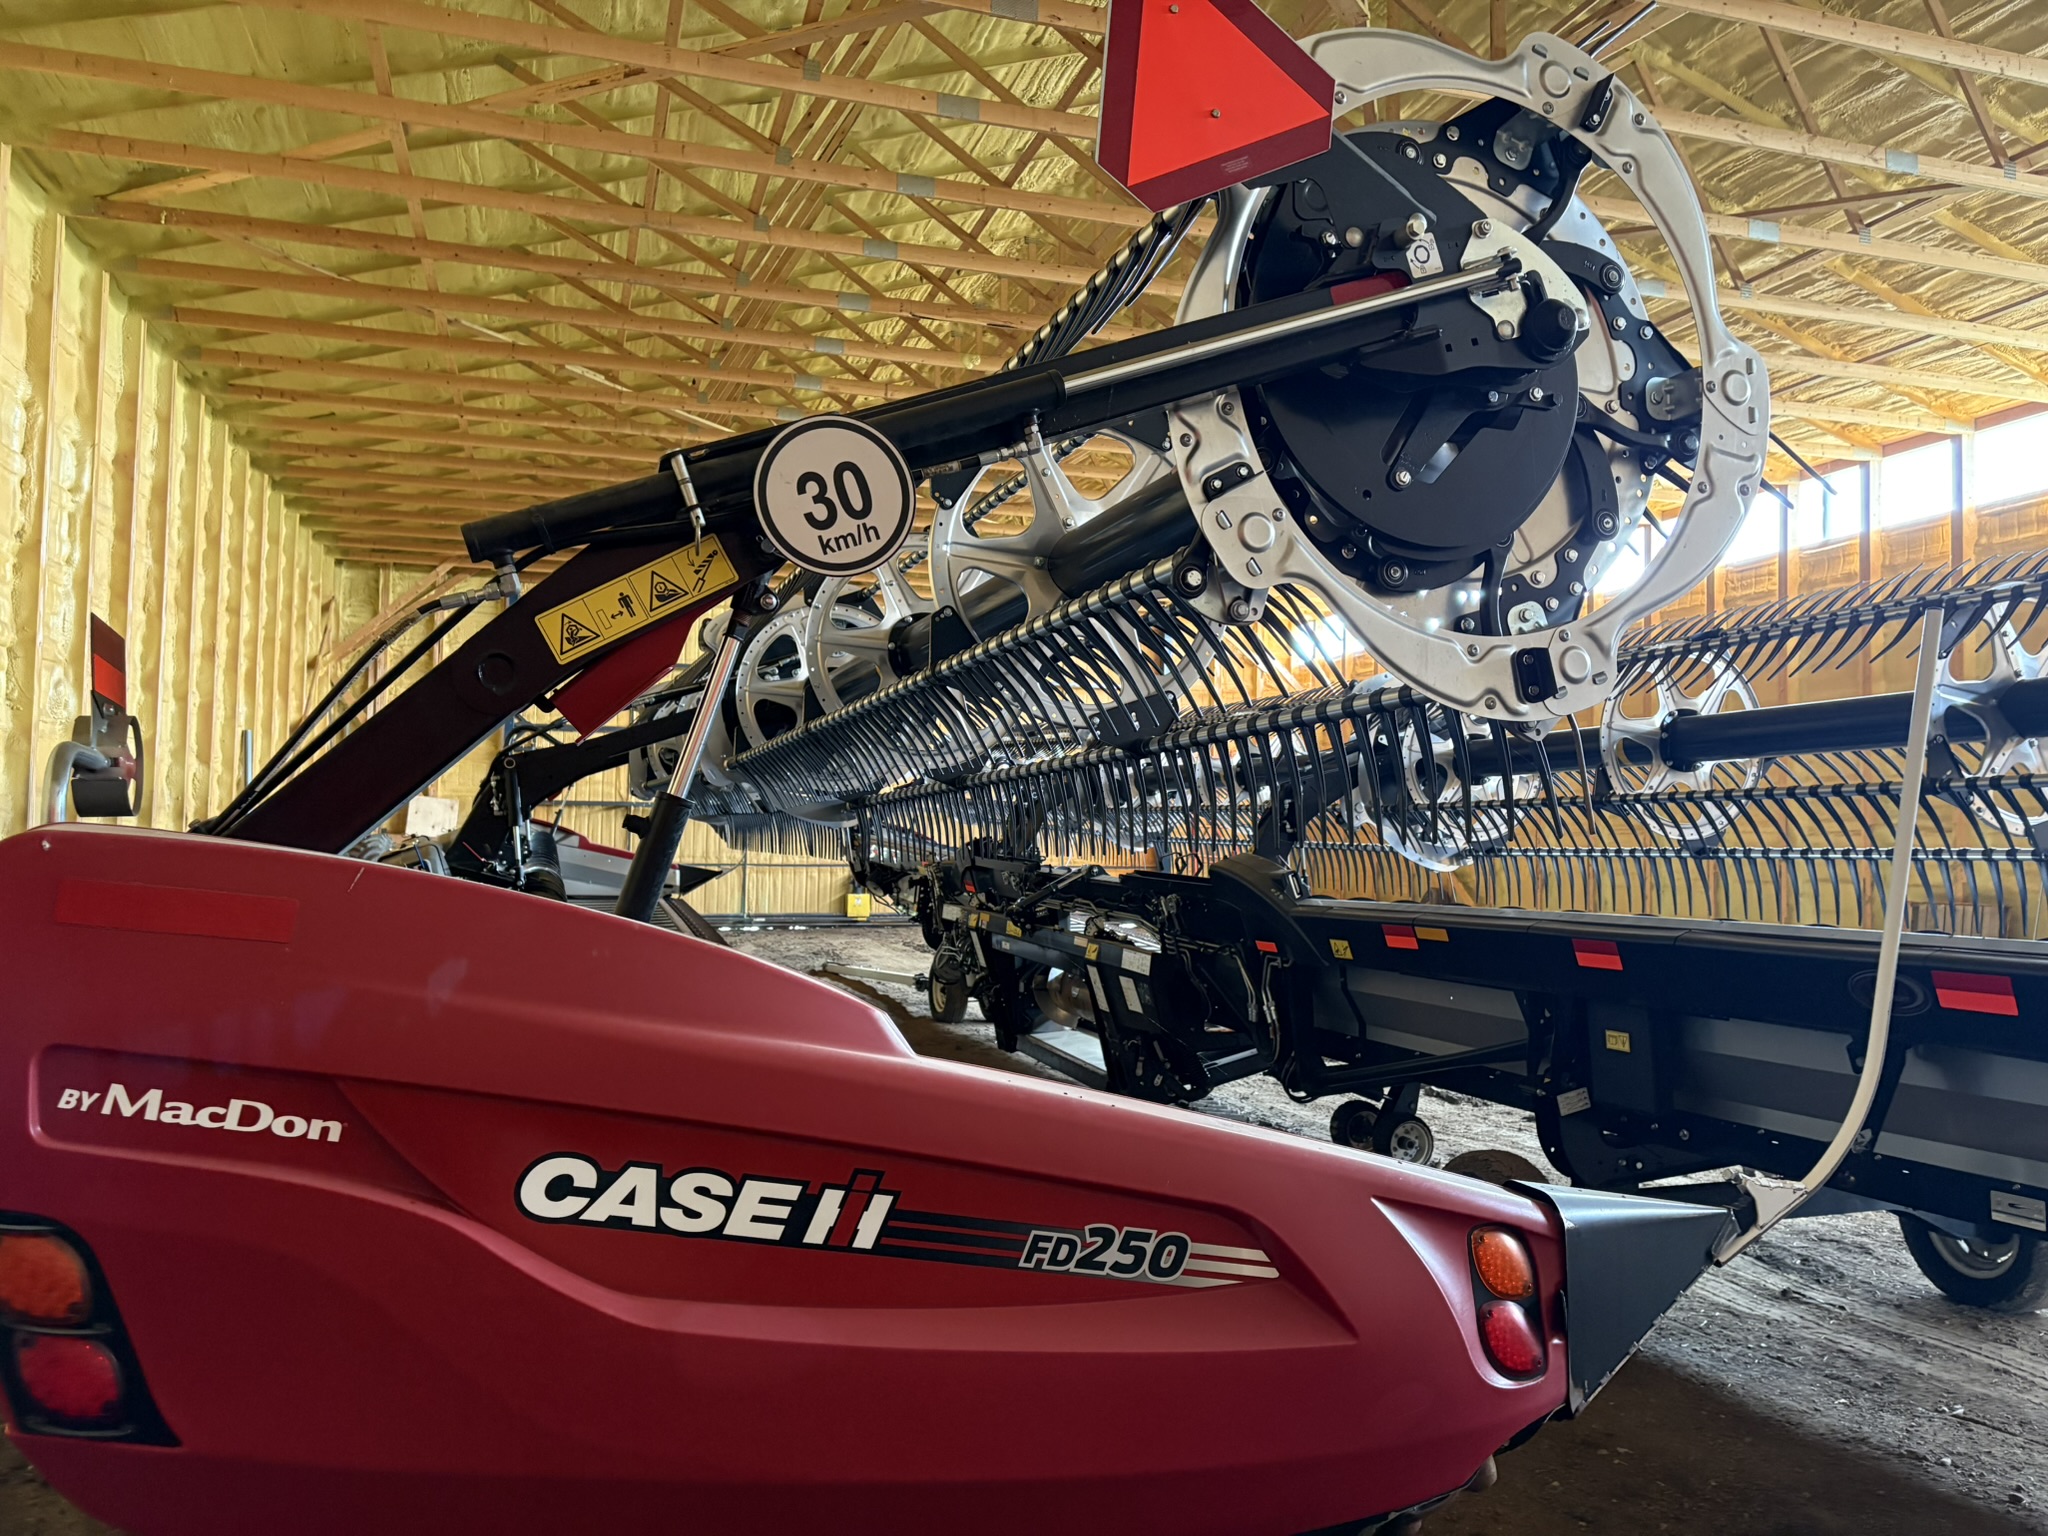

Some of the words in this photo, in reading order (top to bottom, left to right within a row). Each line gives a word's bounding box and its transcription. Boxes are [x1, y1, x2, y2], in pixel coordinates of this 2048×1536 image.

[796, 460, 873, 531] 30
[817, 522, 881, 556] km/h
[56, 1088, 101, 1112] BY
[100, 1083, 343, 1143] MacDon
[519, 1156, 803, 1241] CASE
[1018, 1223, 1192, 1282] FD250
